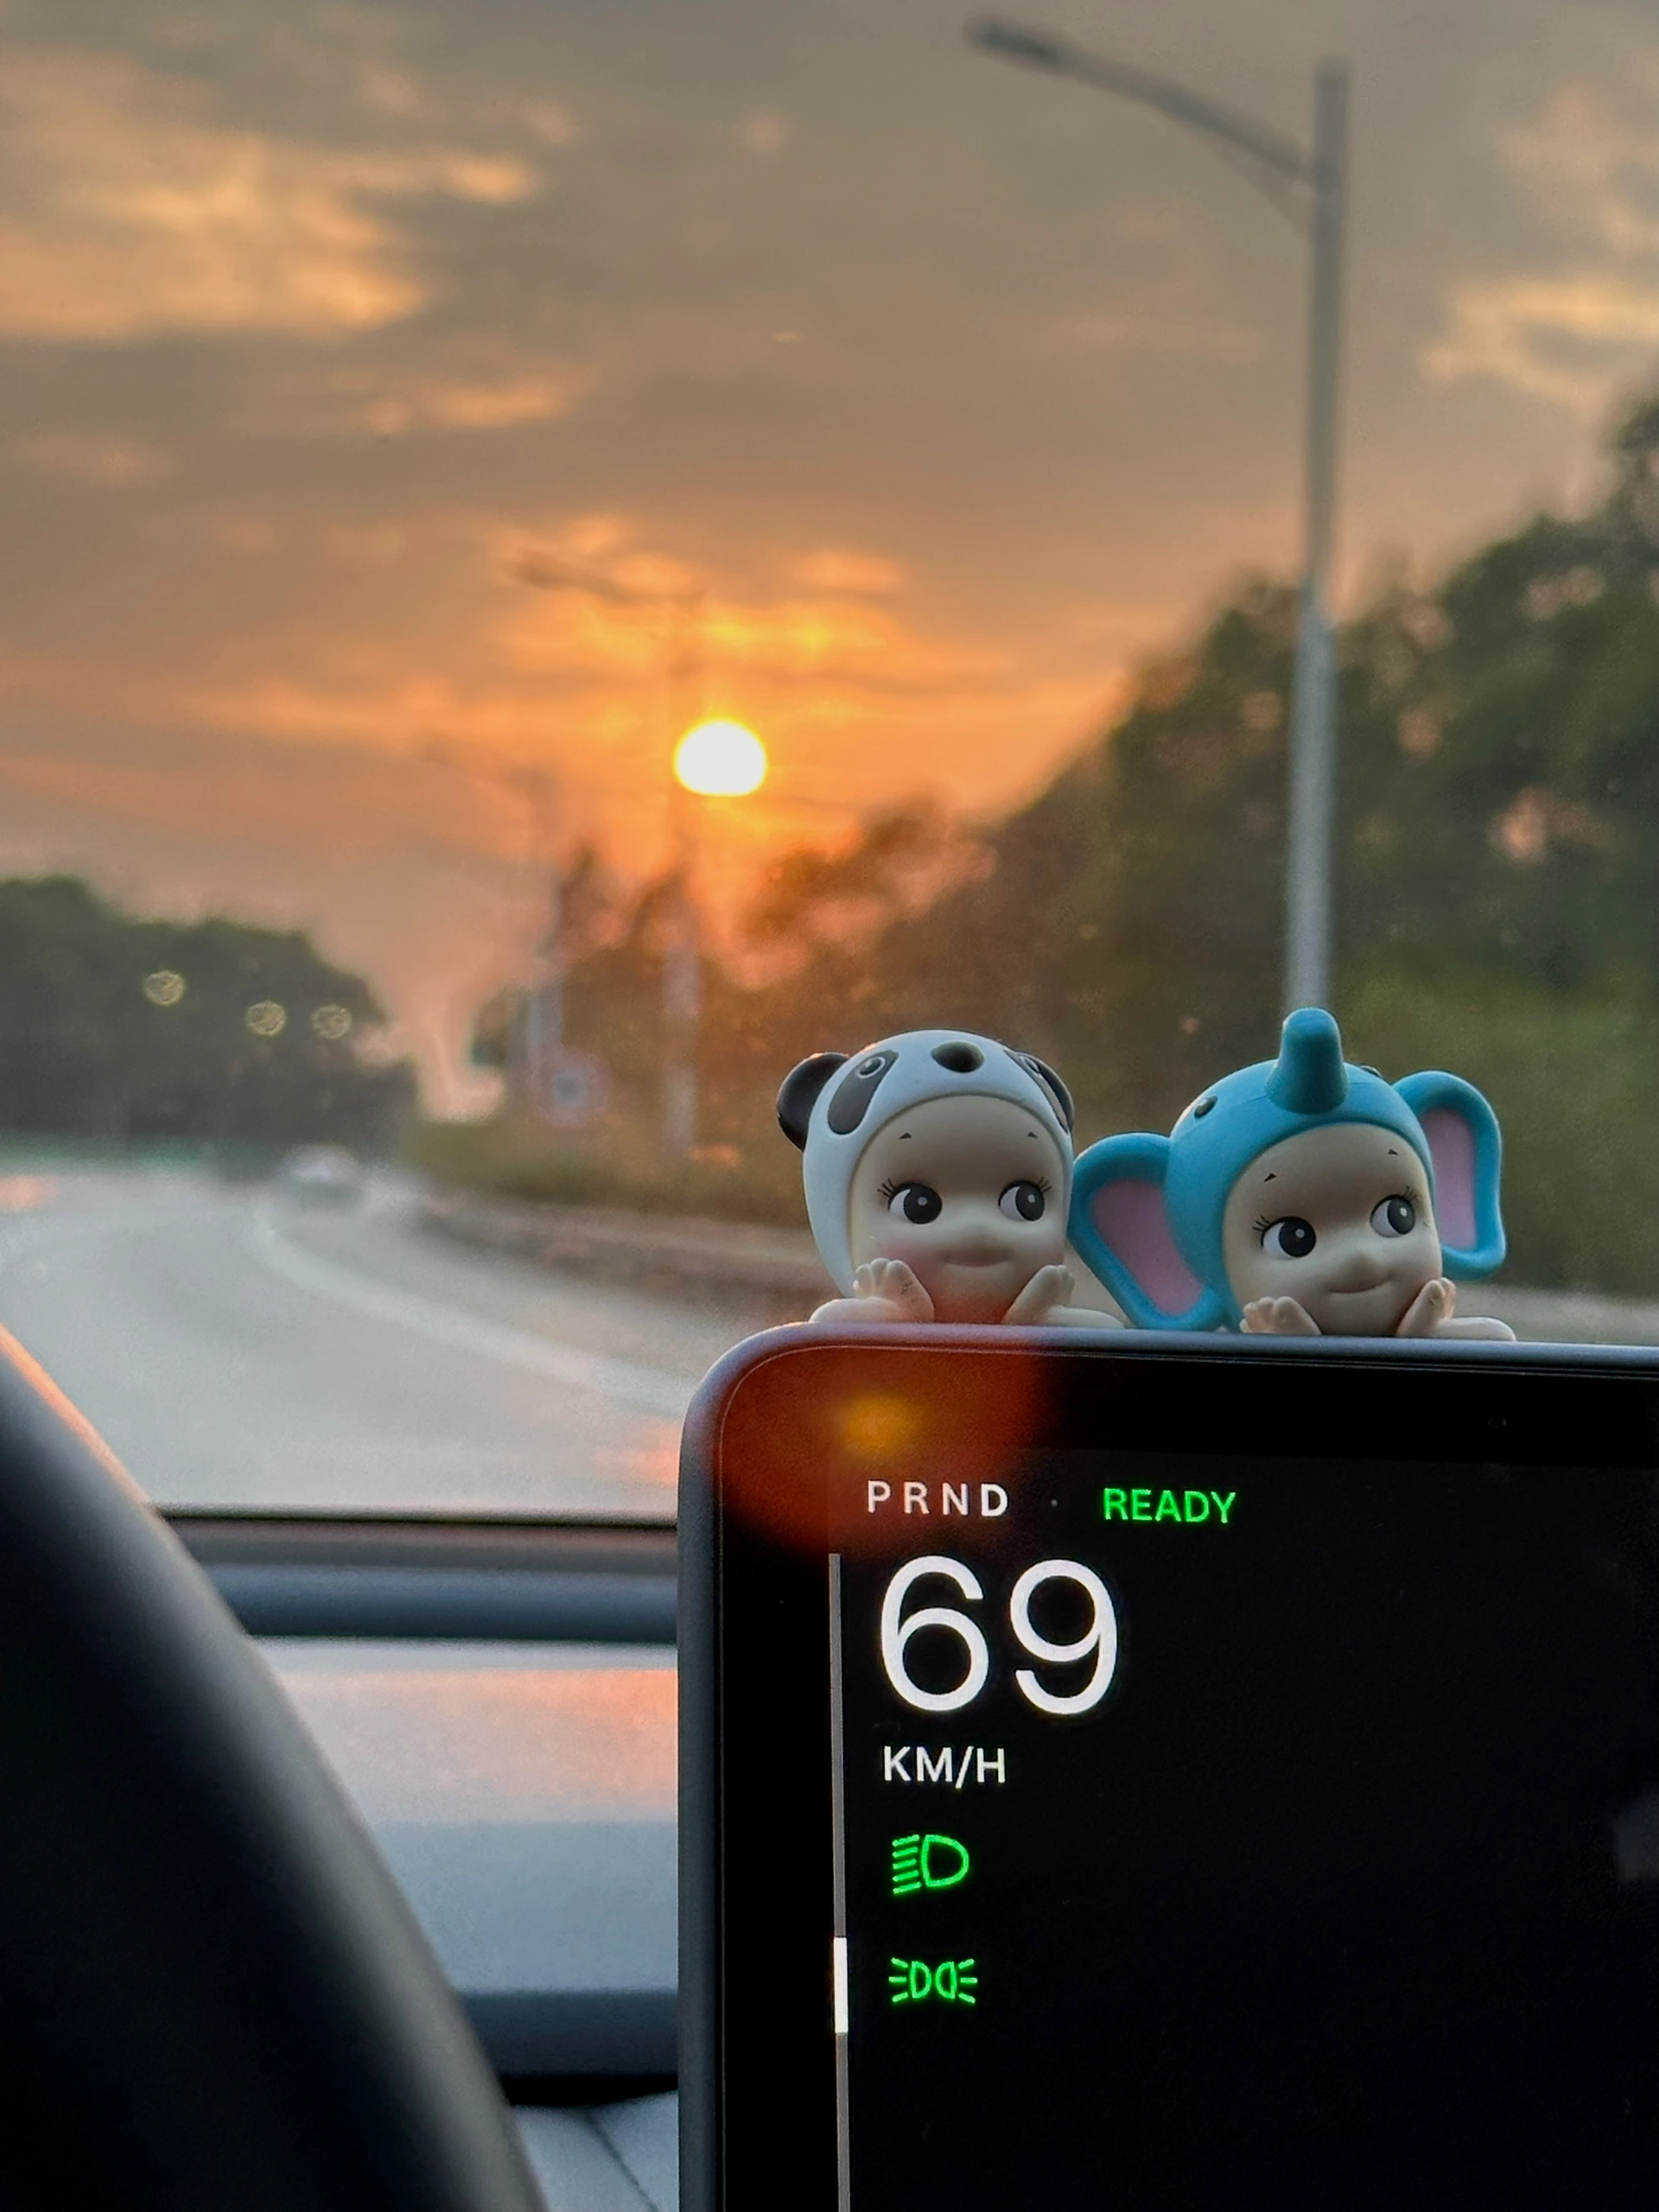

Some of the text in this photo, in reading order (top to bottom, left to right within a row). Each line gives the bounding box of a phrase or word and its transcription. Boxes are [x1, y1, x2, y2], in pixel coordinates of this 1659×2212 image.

[1103, 1487, 1236, 1524] READY
[880, 1555, 1118, 1715] 69
[883, 1745, 1007, 1789] KM/H
